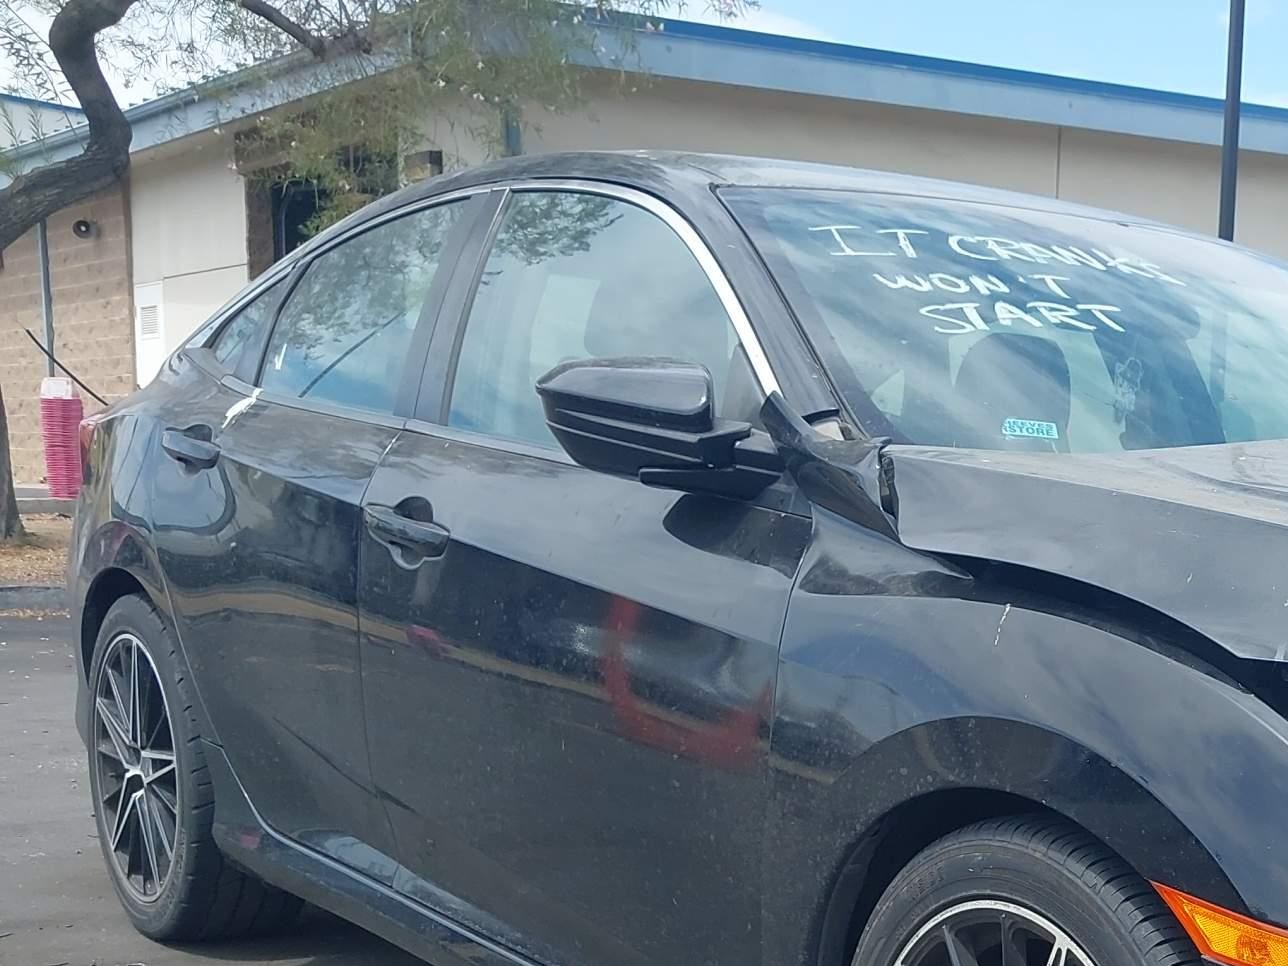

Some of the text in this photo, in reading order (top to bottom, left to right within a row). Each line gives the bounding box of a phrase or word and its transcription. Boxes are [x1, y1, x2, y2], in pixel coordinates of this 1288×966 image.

[808, 225, 929, 258] IT
[872, 272, 1072, 300] WON'T
[919, 302, 1126, 335] START
